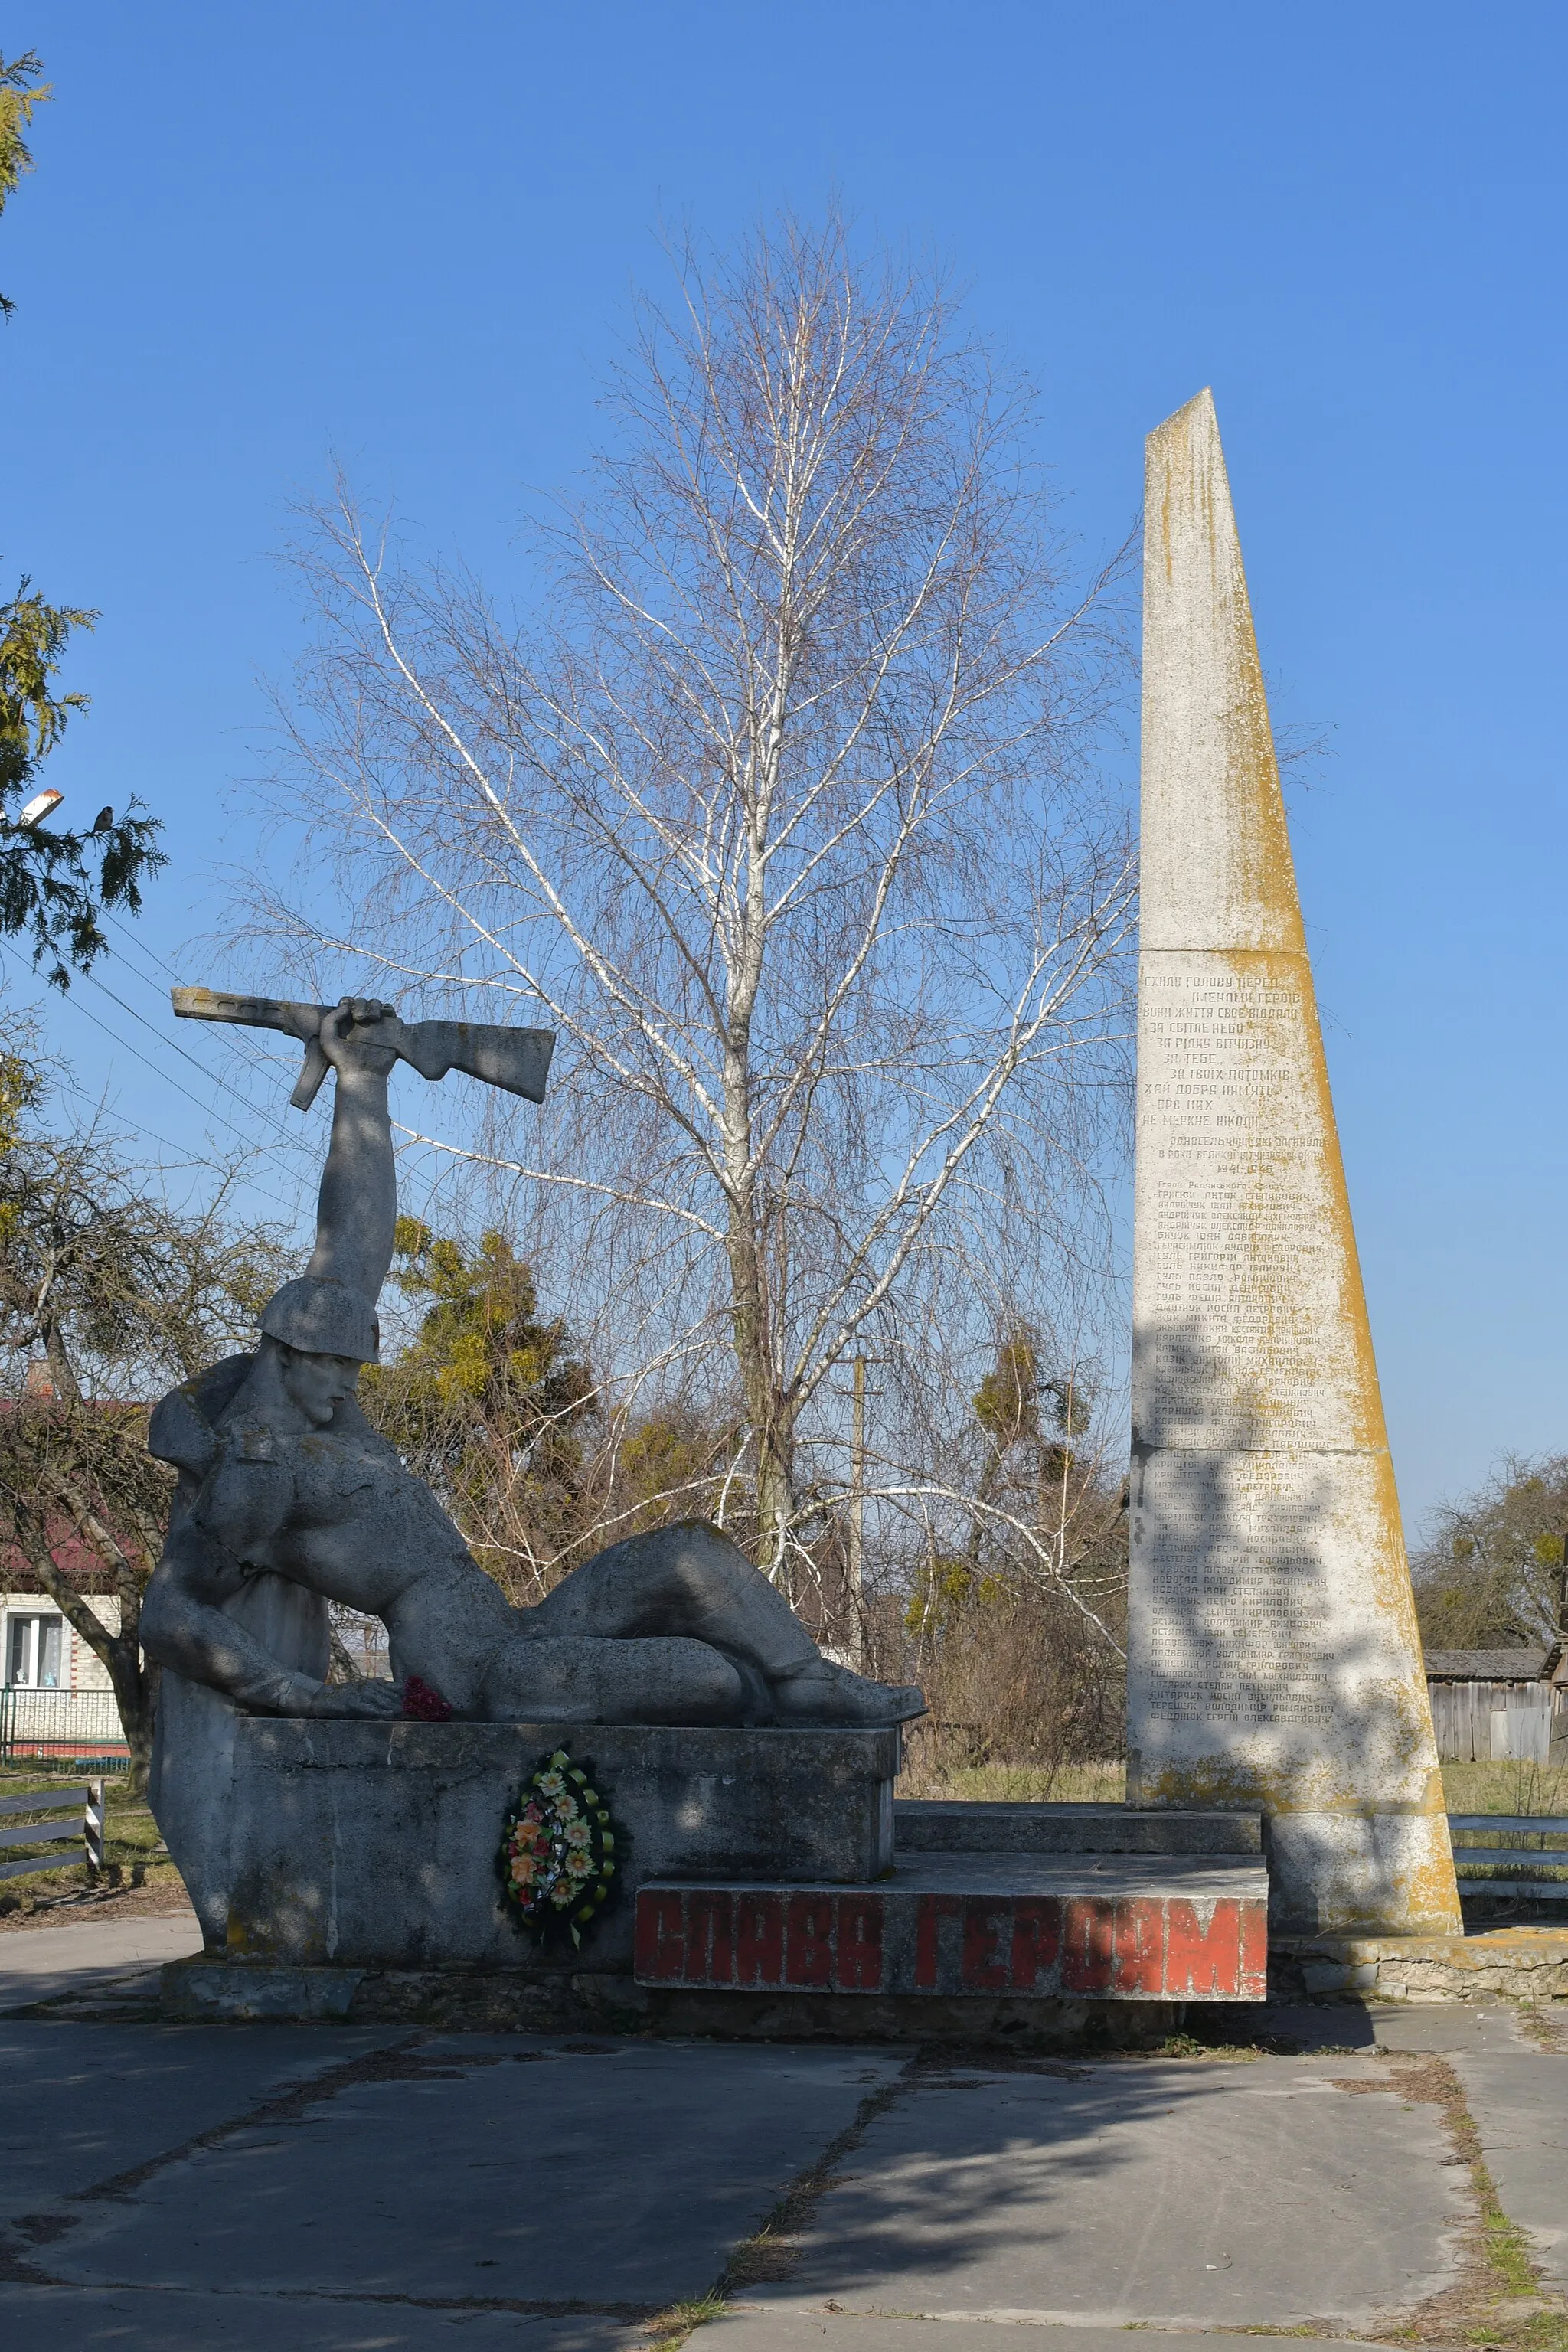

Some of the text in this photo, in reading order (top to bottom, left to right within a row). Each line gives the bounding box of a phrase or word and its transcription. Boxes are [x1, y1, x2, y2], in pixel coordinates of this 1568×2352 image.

[1187, 977, 1233, 988] ГОЛОВУ
[1237, 977, 1279, 988] ПЕРЕД
[1143, 1008, 1171, 1018] ВОНИ
[1174, 1008, 1213, 1018] ЖИТТЯ
[1150, 1023, 1243, 1034] ЗА СВІТЛЕ НЕБО
[1157, 1038, 1270, 1049] ЗА РІДНУ ВІТЧИЗНУ
[1164, 1054, 1178, 1063] ЗА
[1171, 1069, 1184, 1079] ЗА
[1230, 1070, 1289, 1080] ПОТОМКІВ
[1145, 1082, 1170, 1094] ХАЙ
[1176, 1084, 1216, 1095] ДОБРА
[1158, 1099, 1213, 1110] ПРО НИХ
[1143, 1115, 1259, 1127] НЕ МЕРКНЕ НІКОЛИ
[1159, 1150, 1165, 1159] В
[1212, 1212, 1261, 1220] ОЛЕКСАНДР
[1189, 1253, 1236, 1261] ГРИГОРІЙ
[1233, 1587, 1296, 1596] СТЕПАНОВИЧ
[1207, 1597, 1236, 1606] ПЕТРО
[1198, 1681, 1233, 1690] СТЕПАН
[1207, 1711, 1238, 1721] СЕРГІЙ
[635, 1889, 883, 1988] СЛАВА
